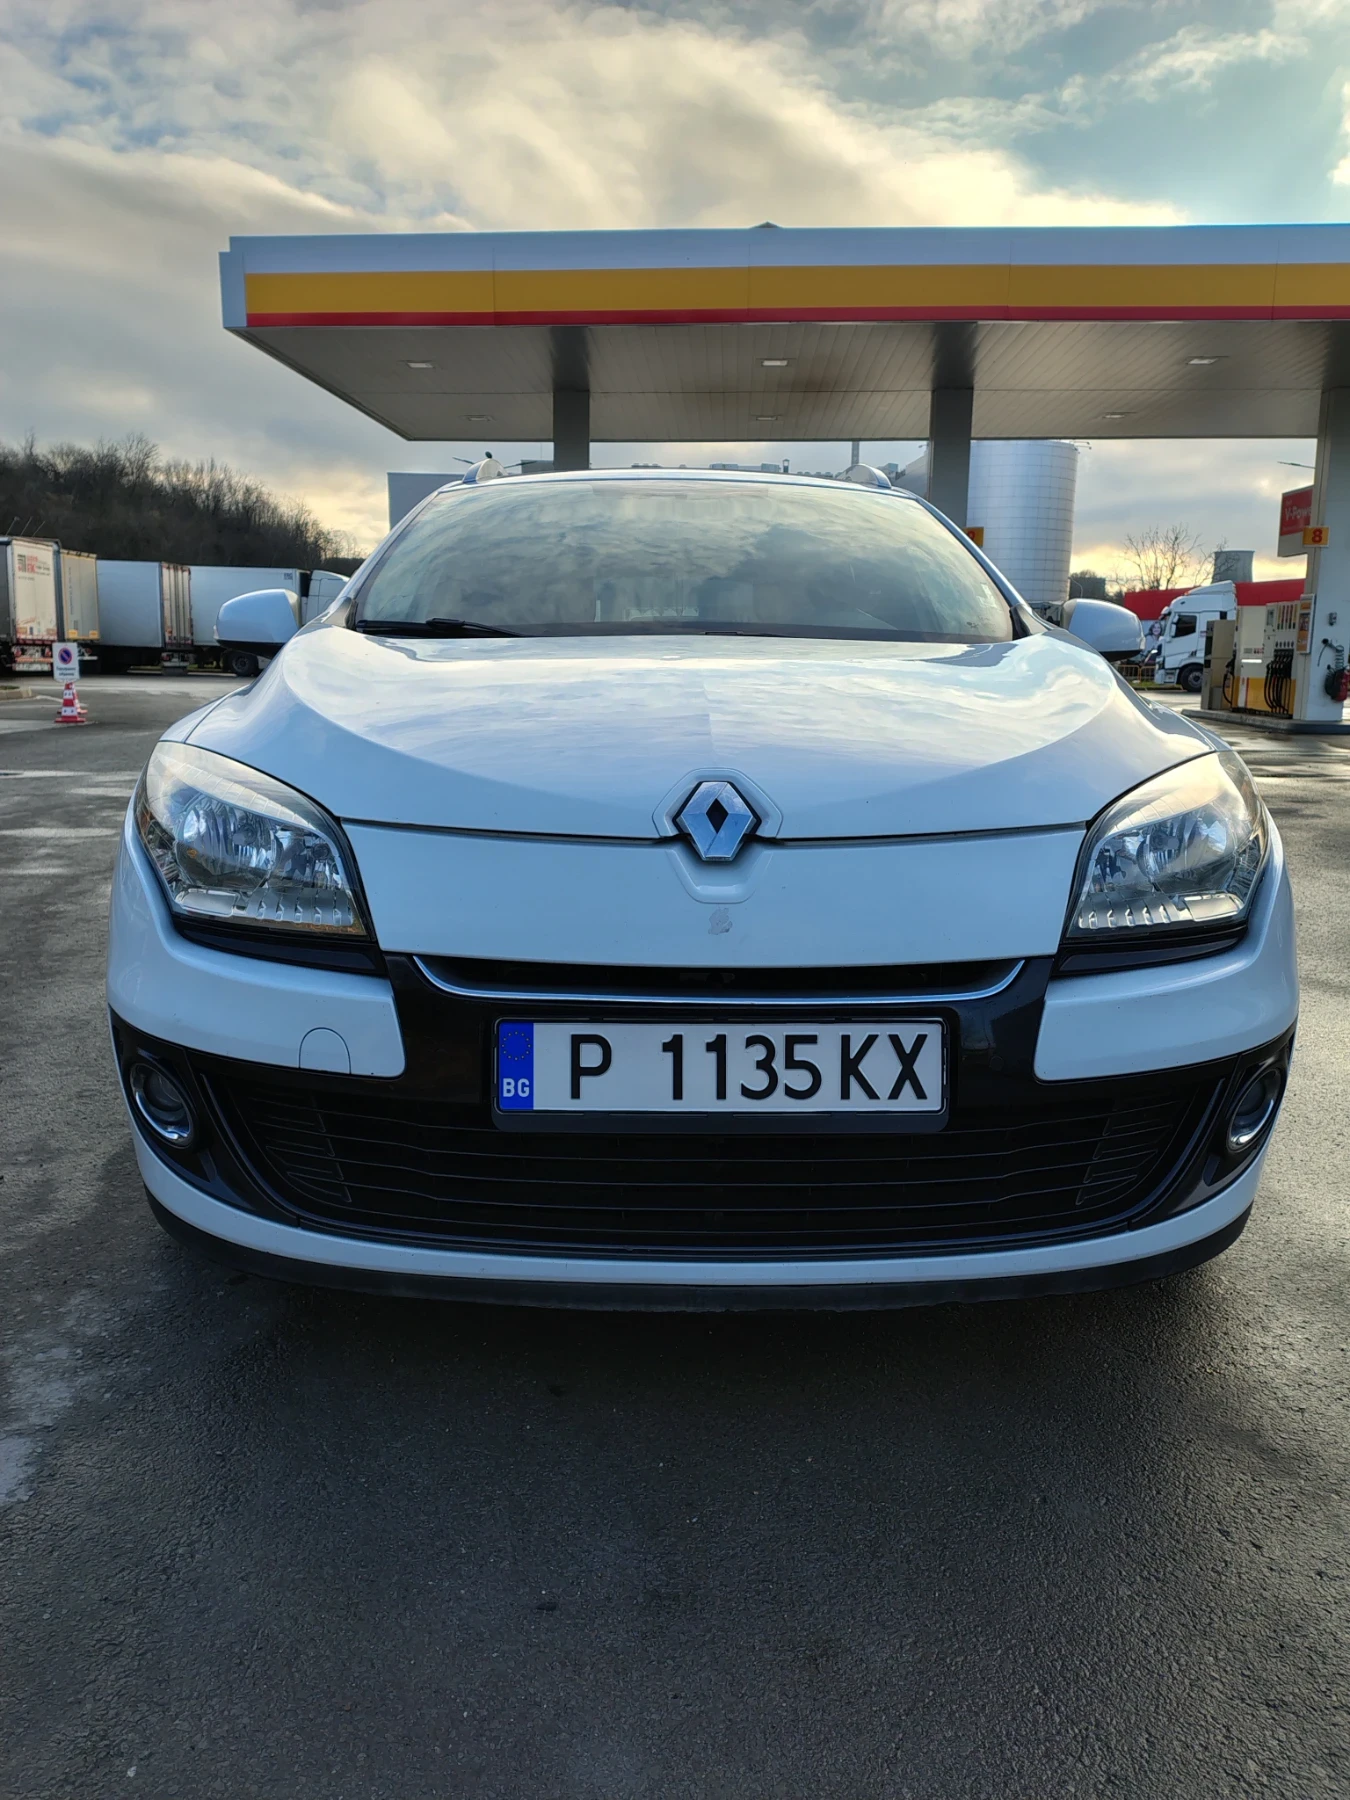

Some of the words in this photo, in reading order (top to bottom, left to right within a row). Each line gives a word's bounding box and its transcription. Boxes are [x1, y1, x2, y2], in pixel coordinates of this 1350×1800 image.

[1311, 527, 1323, 545] 8
[570, 1033, 612, 1100] P
[503, 1077, 530, 1098] BG
